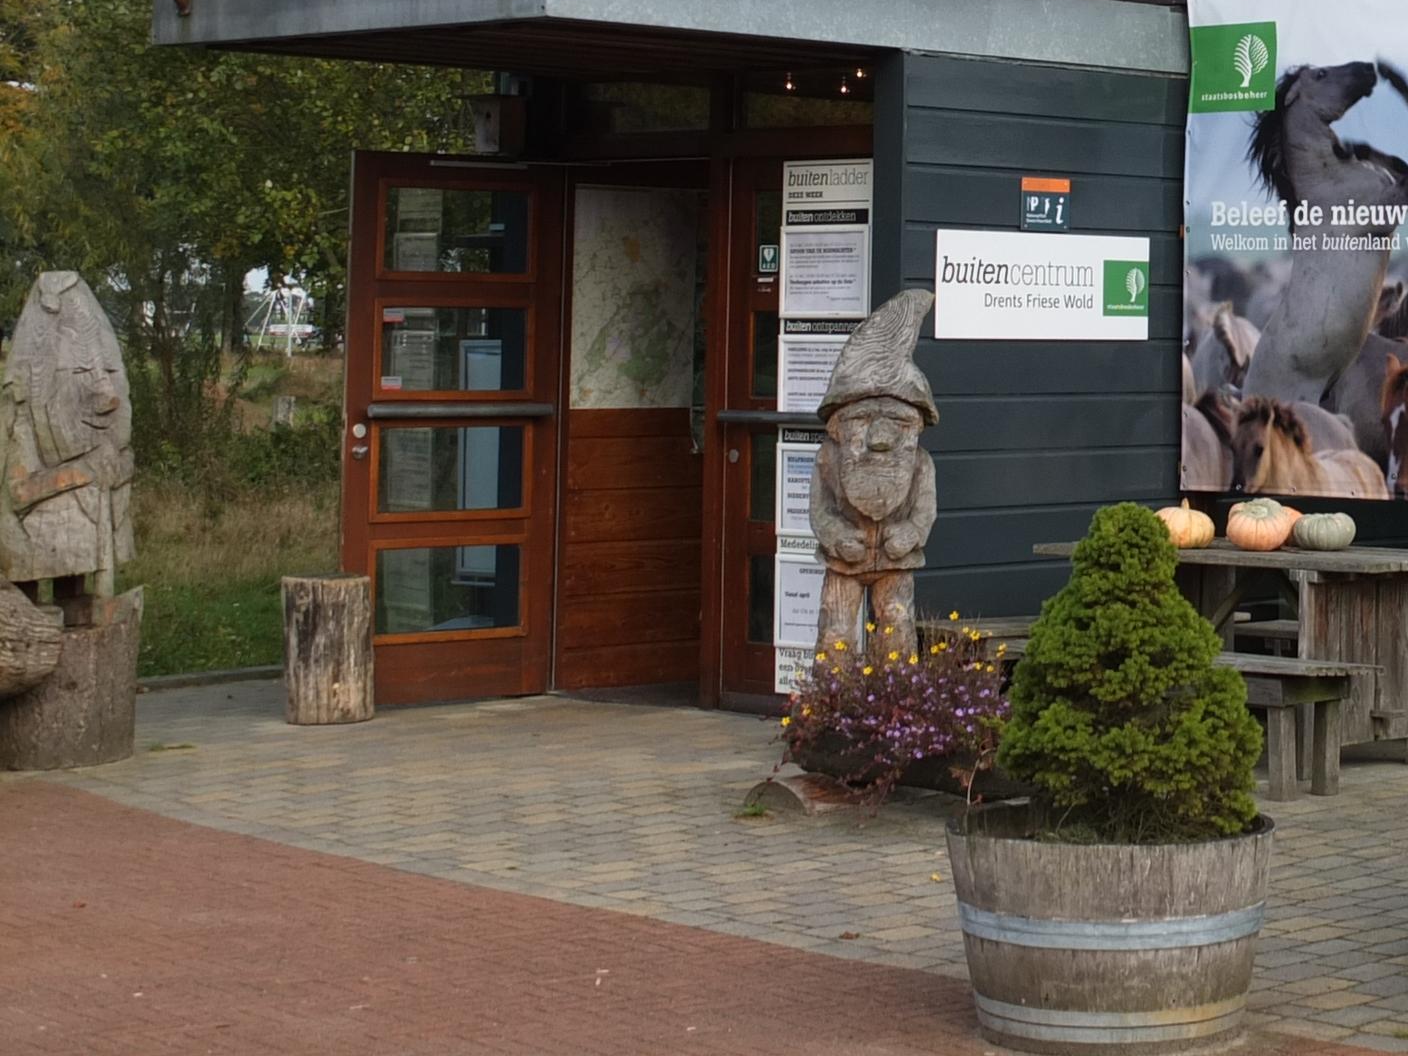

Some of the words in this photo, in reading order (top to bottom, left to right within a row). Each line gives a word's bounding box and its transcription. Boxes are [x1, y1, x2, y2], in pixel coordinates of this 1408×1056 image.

[1201, 90, 1268, 101] staatsbosbeheer
[788, 167, 869, 187] buitenladder
[1210, 199, 1287, 226] Beleef
[1293, 199, 1324, 226] de
[1210, 234, 1269, 251] Welkom
[1273, 234, 1288, 251] in
[1292, 233, 1317, 251] het
[1322, 233, 1401, 251] buitenland
[941, 255, 1094, 287] buitencentrum
[984, 293, 1023, 308] Drents
[1026, 293, 1060, 309] Friese
[1064, 294, 1094, 309] Wold
